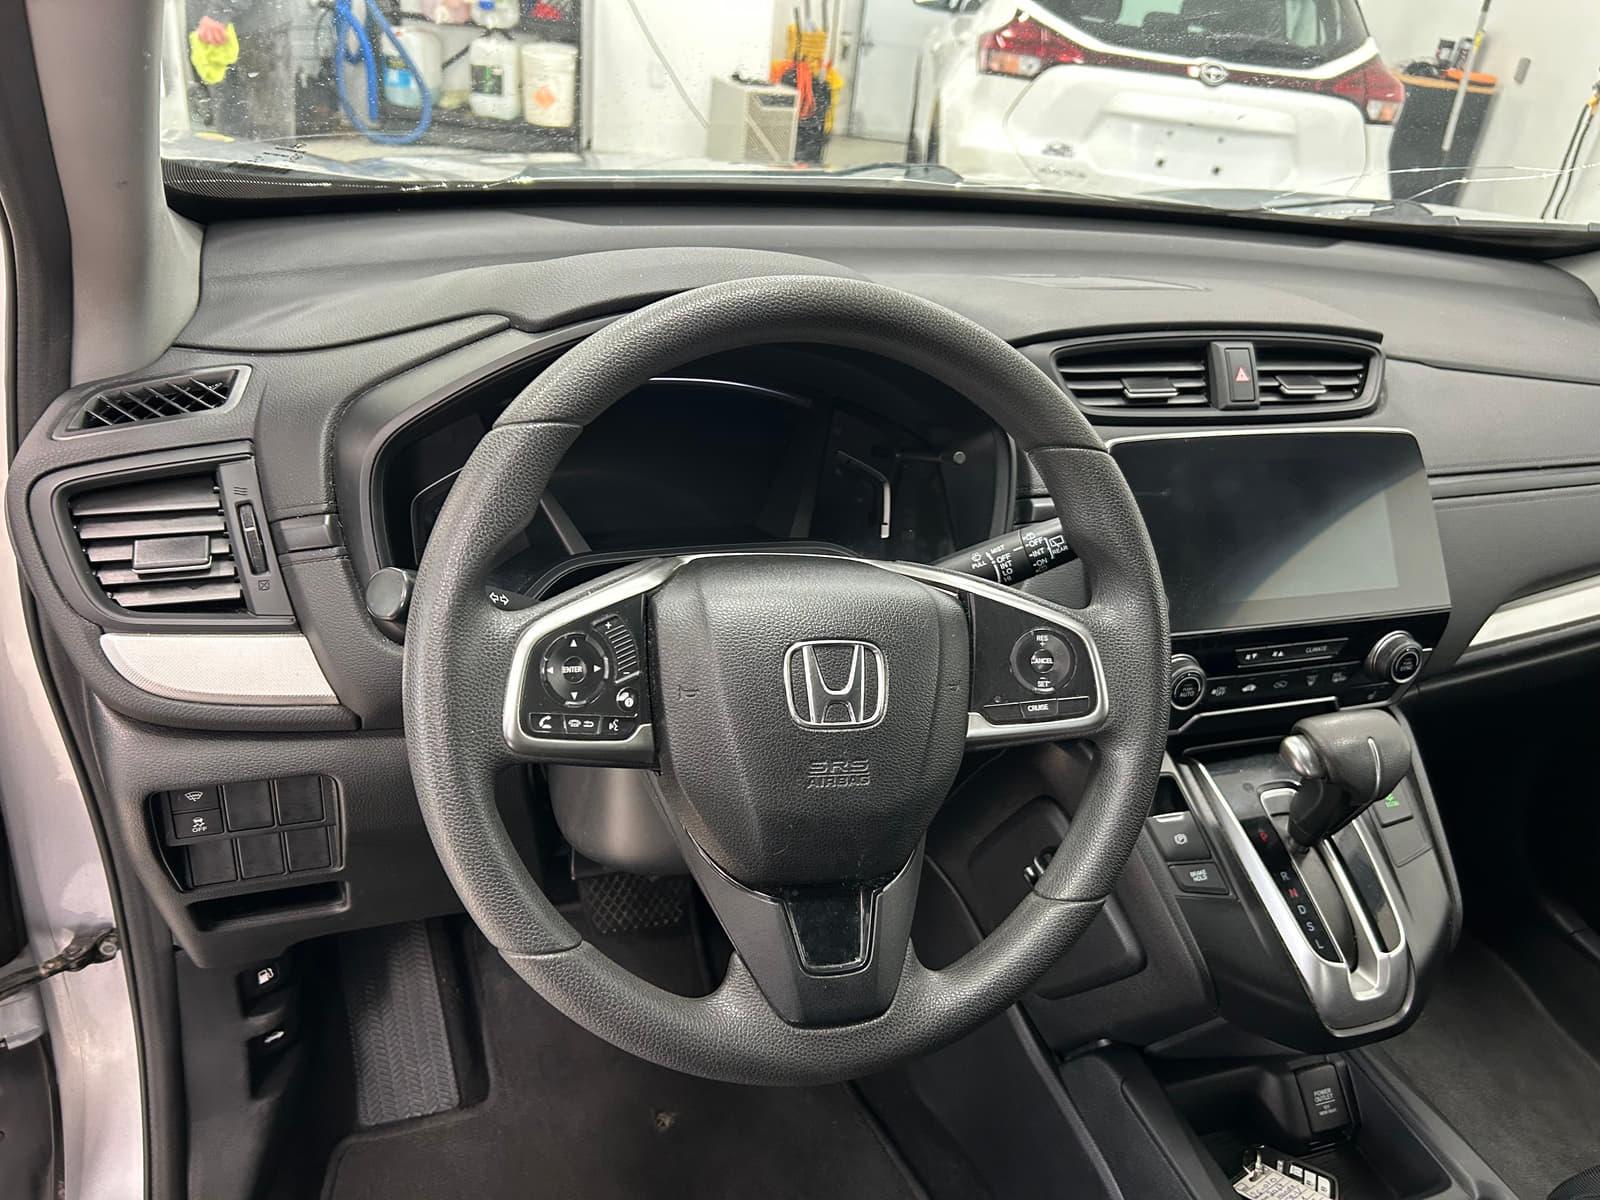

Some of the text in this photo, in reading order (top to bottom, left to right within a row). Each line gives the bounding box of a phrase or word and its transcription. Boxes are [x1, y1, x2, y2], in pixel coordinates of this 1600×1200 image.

[1028, 536, 1045, 548] OFF
[1031, 547, 1046, 558] INT
[1052, 544, 1069, 555] REAR
[996, 551, 1012, 563] OFF
[1036, 557, 1048, 567] ON
[971, 559, 988, 570] PULL
[999, 560, 1013, 569] INT
[1001, 568, 1014, 577] LO
[1036, 634, 1049, 642] RES
[561, 665, 583, 674] ENTER
[1037, 680, 1051, 688] SET
[1027, 703, 1049, 712] CRUISE
[808, 759, 869, 774] SRS
[806, 774, 871, 789] AIRBAG
[191, 825, 208, 833] OFF
[1259, 831, 1269, 842] P
[1280, 871, 1290, 881] R
[1297, 904, 1307, 915] D
[1306, 921, 1315, 932] S
[1315, 939, 1325, 949] L
